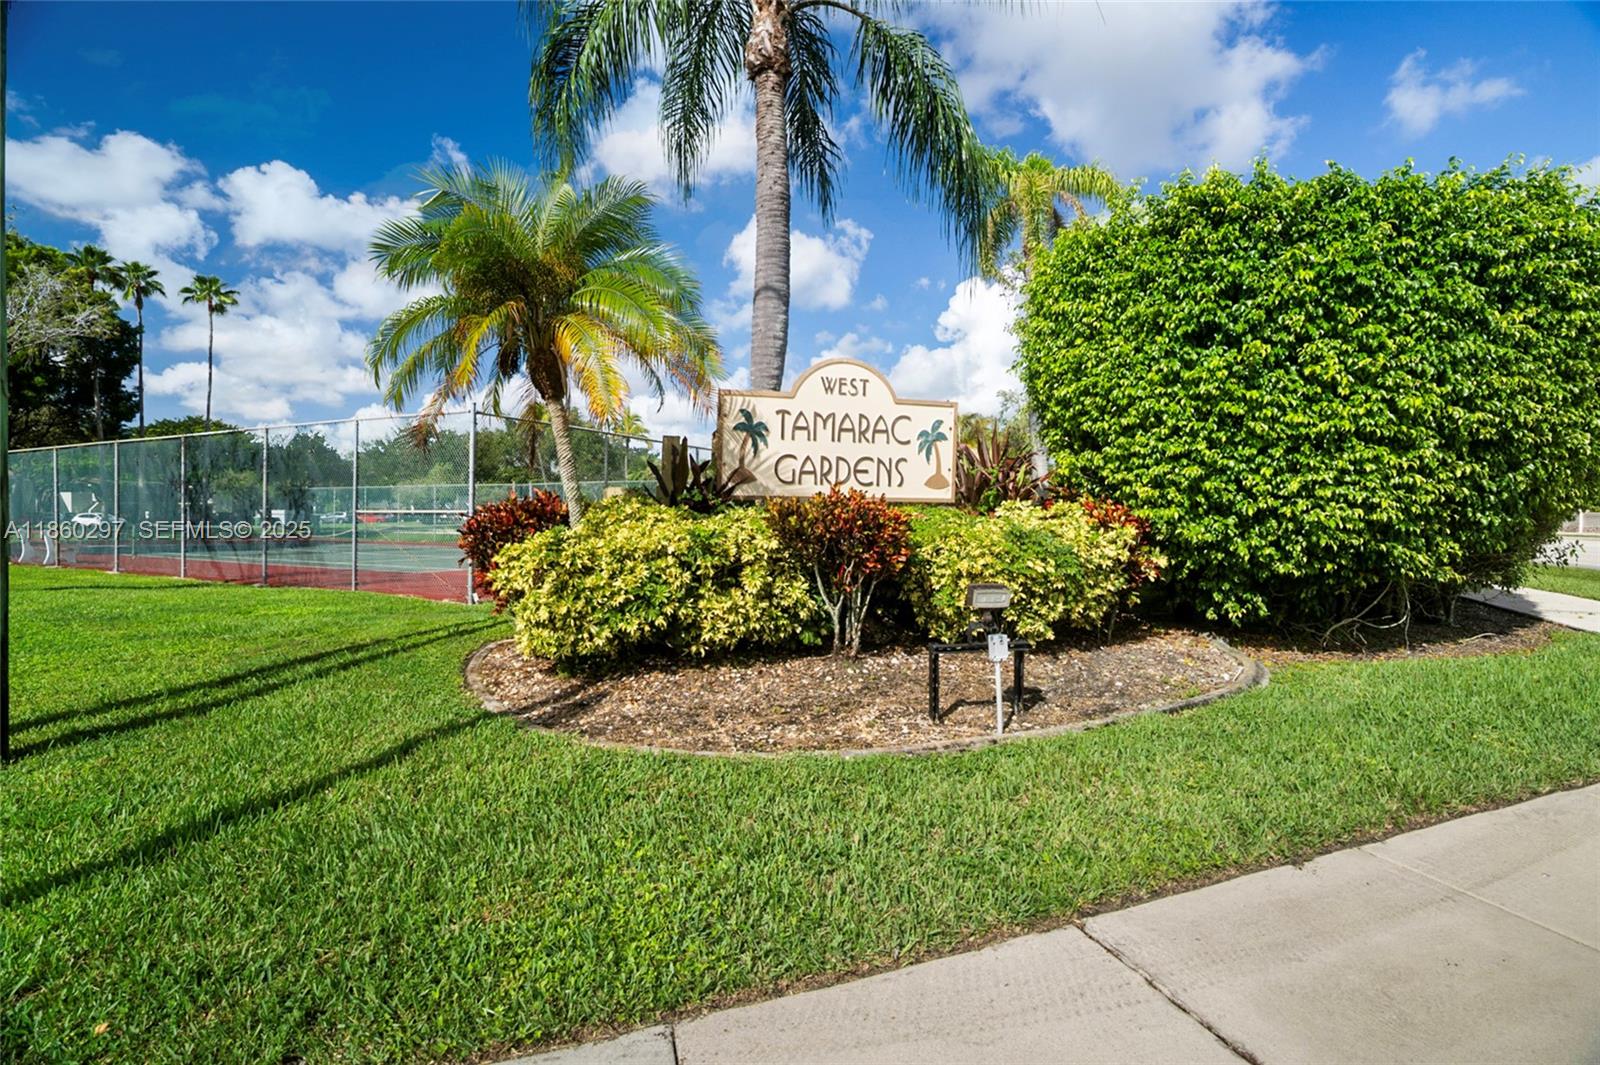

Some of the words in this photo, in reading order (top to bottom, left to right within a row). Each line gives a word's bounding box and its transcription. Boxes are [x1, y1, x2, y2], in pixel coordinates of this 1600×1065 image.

[820, 376, 870, 397] WEST
[775, 409, 912, 445] TAMARAC
[774, 453, 908, 488] GARDENS
